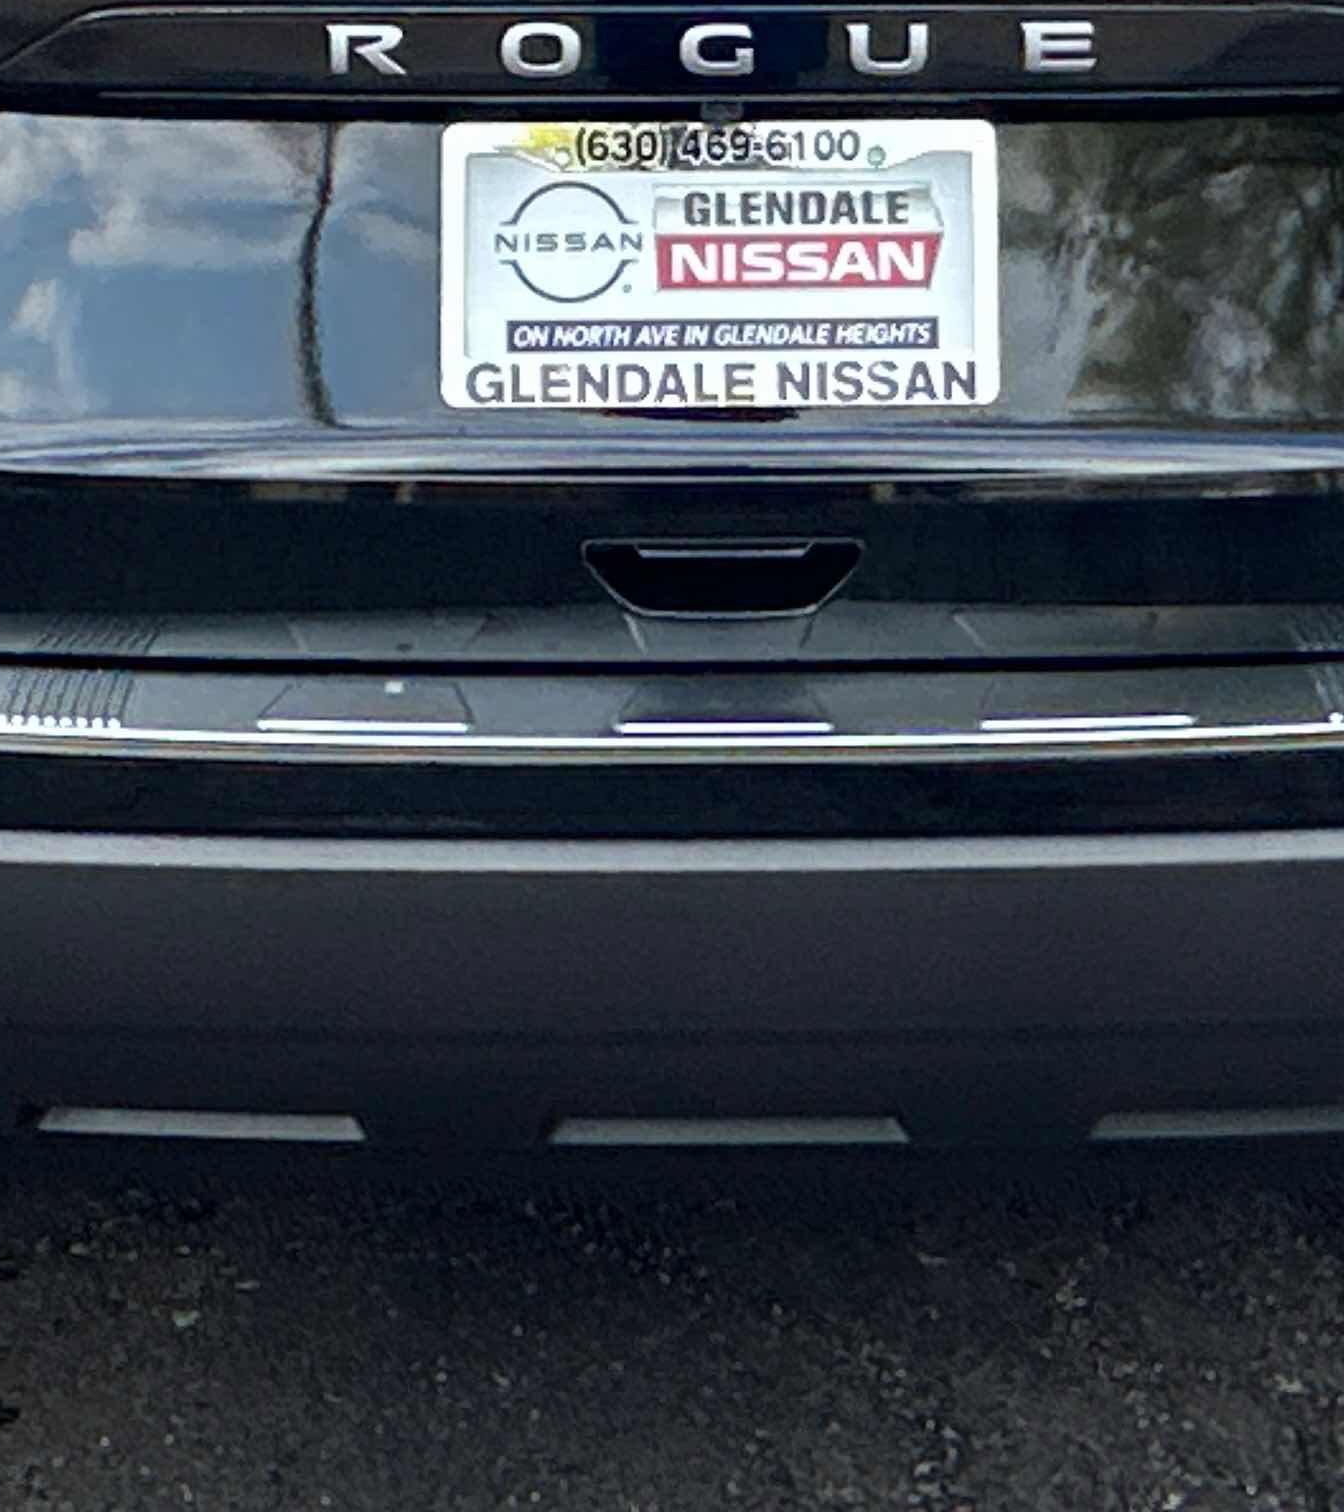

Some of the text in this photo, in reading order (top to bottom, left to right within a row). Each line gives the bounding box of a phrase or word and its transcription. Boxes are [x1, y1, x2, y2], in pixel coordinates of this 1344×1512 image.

[324, 21, 1097, 77] ROGUE
[683, 190, 910, 226] GLENDALE
[493, 233, 643, 252] NISSAN
[670, 240, 926, 284] NISSAN
[513, 322, 932, 348] ON NORTH AVE IN GLENDALE HEIGHTS
[465, 360, 977, 403] GLENDALE NISSAN
